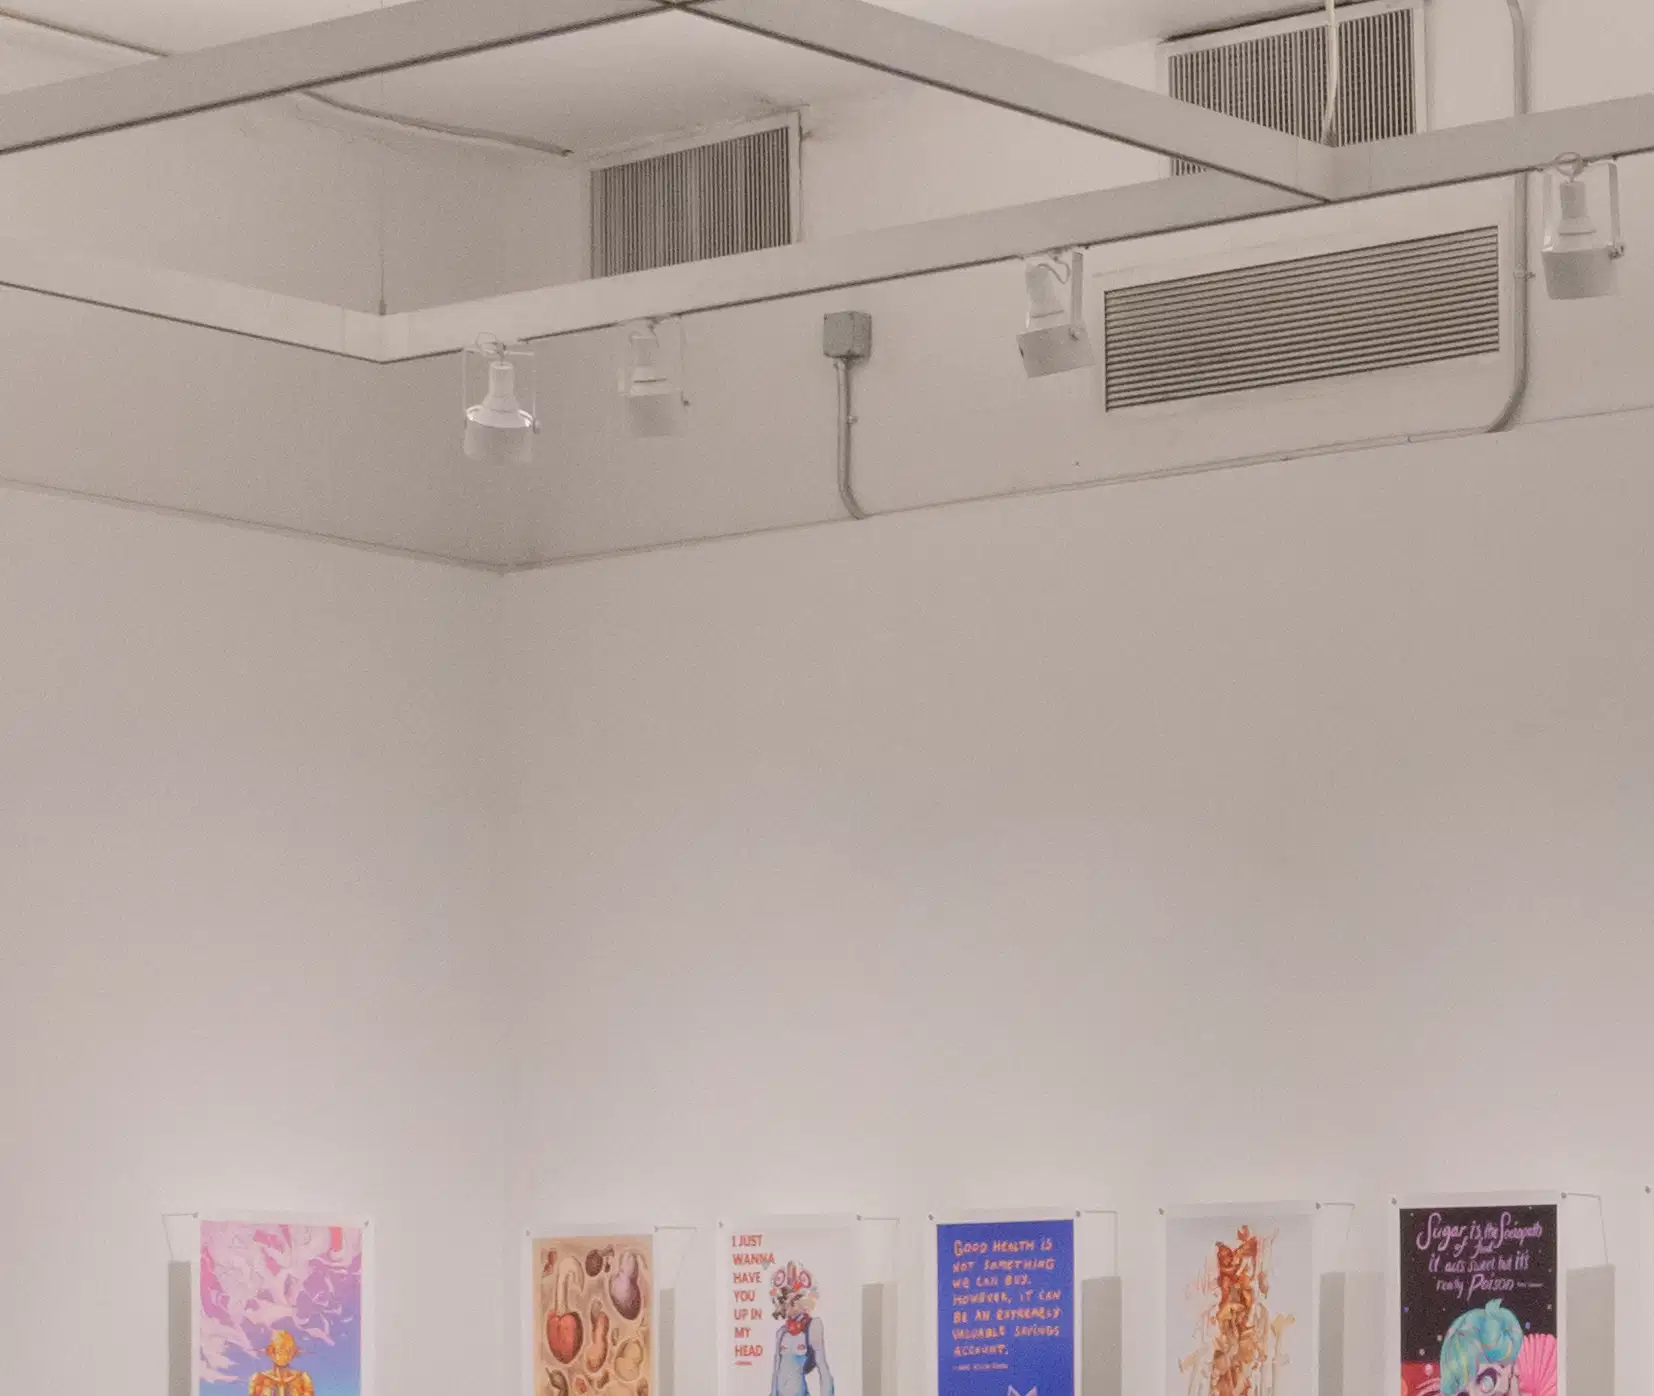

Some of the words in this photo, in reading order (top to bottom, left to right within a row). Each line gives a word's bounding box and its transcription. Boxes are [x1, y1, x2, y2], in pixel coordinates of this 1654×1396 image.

[1416, 1212, 1466, 1251] Sugar
[1469, 1220, 1481, 1240] is
[738, 1234, 763, 1247] JUST
[992, 1239, 1035, 1253] HEALTH
[732, 1252, 776, 1266] WANNA
[984, 1258, 1056, 1270] SOMETHING
[732, 1271, 763, 1284] HAVE
[733, 1289, 756, 1302] YOU
[733, 1308, 749, 1320] UP
[750, 1307, 763, 1320] IN
[734, 1327, 751, 1338] MY
[734, 1344, 764, 1357] HEAD
